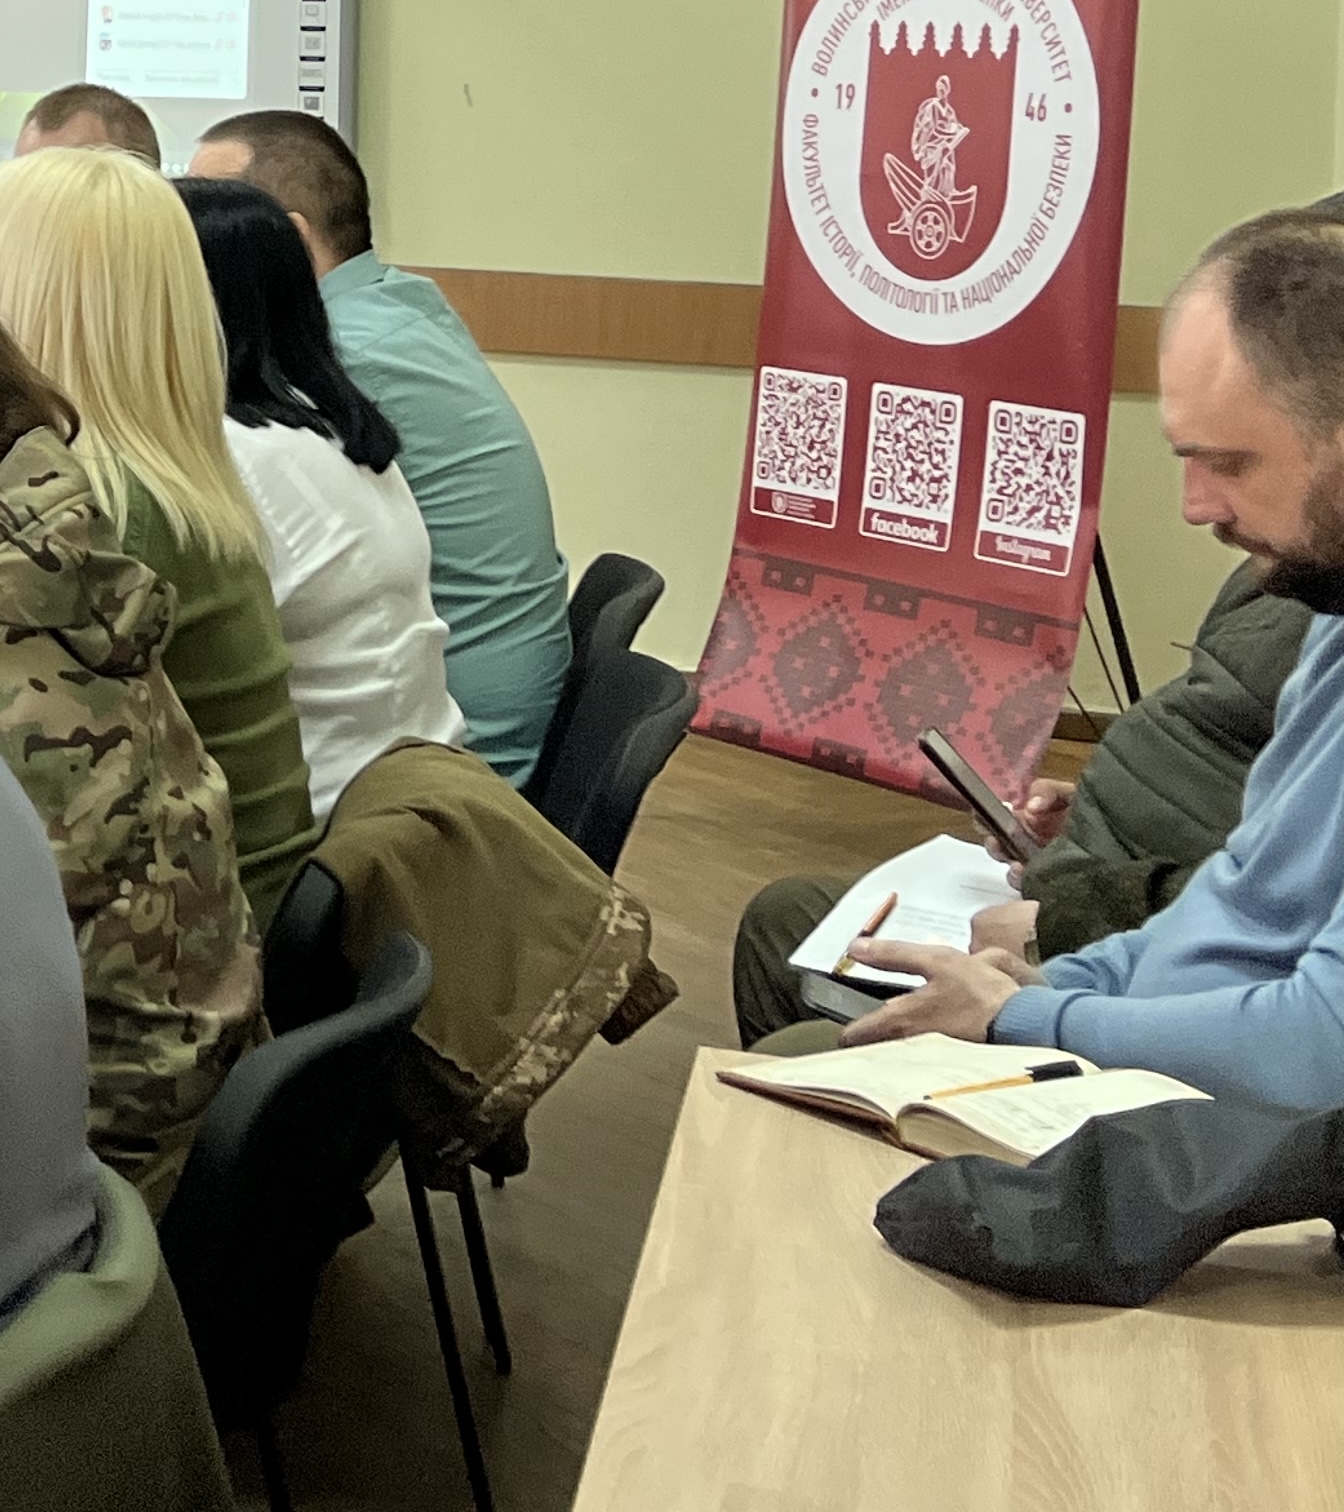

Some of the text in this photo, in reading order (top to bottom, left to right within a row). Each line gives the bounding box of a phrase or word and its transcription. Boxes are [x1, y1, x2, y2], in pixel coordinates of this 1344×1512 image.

[835, 83, 856, 110] 19
[1024, 92, 1048, 122] 46
[801, 114, 1073, 315] ФАКУЛЬТЕТ ІСТОРІЇ, ПОЛІТОЛОГІЇ ТА НАЦІОНАЛЬНОЇ БЕЗПЕКИ
[870, 512, 939, 544] facebook
